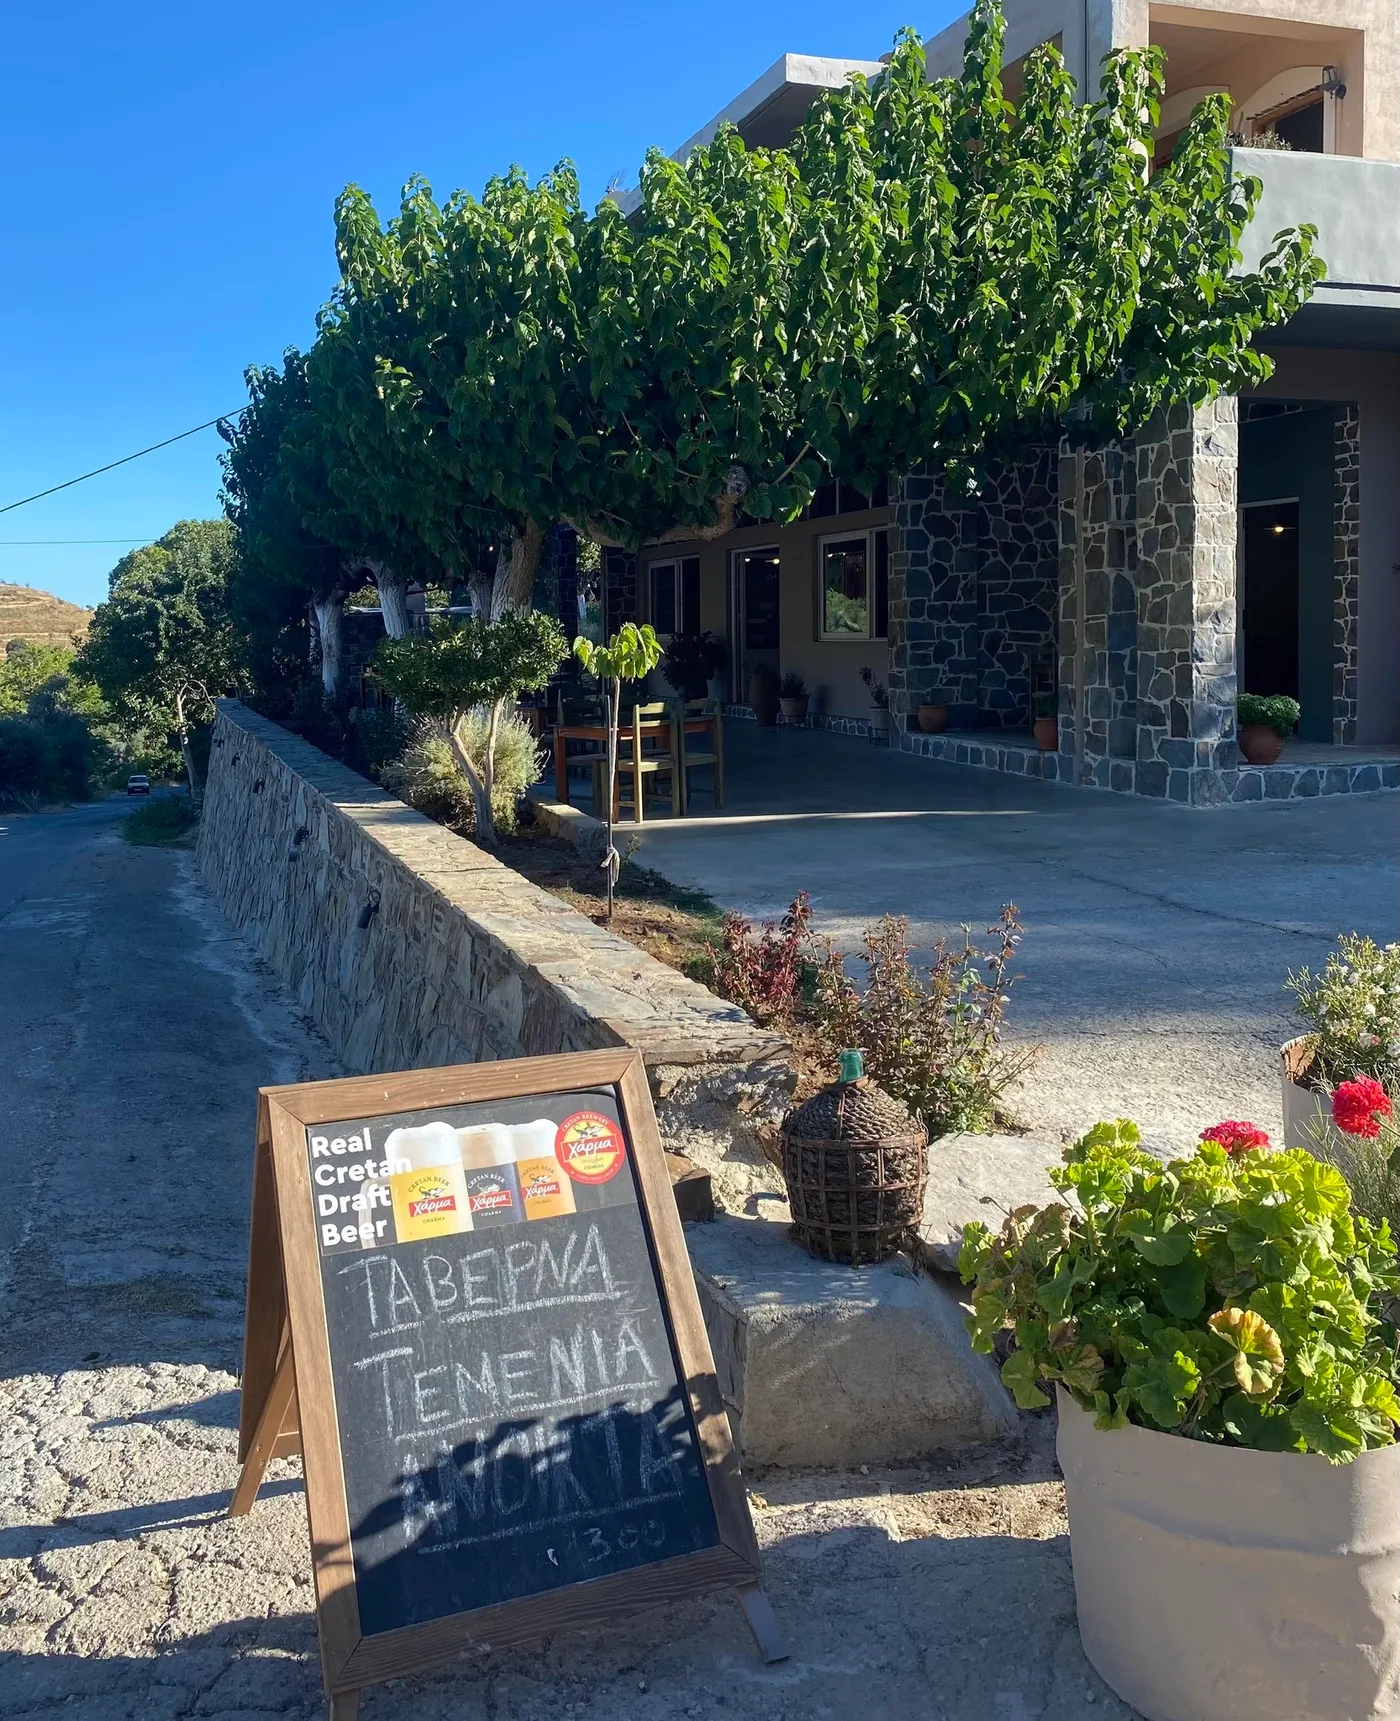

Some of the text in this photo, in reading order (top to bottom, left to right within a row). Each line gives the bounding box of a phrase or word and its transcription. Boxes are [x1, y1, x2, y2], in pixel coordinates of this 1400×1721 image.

[562, 1114, 609, 1132] CRETAN BREWERY
[311, 1127, 372, 1158] Real
[314, 1157, 413, 1186] Cretan
[408, 1176, 450, 1193] CRETAN BEER
[467, 1173, 506, 1189] CRETAN BEER
[521, 1165, 555, 1179] CRETAN BEER
[318, 1183, 392, 1217] Draft
[321, 1219, 388, 1247] Beer
[336, 1223, 616, 1328] ΤΑΒΕΡΝΑ
[353, 1316, 659, 1437] ΤΕΜΕΝΙΑ
